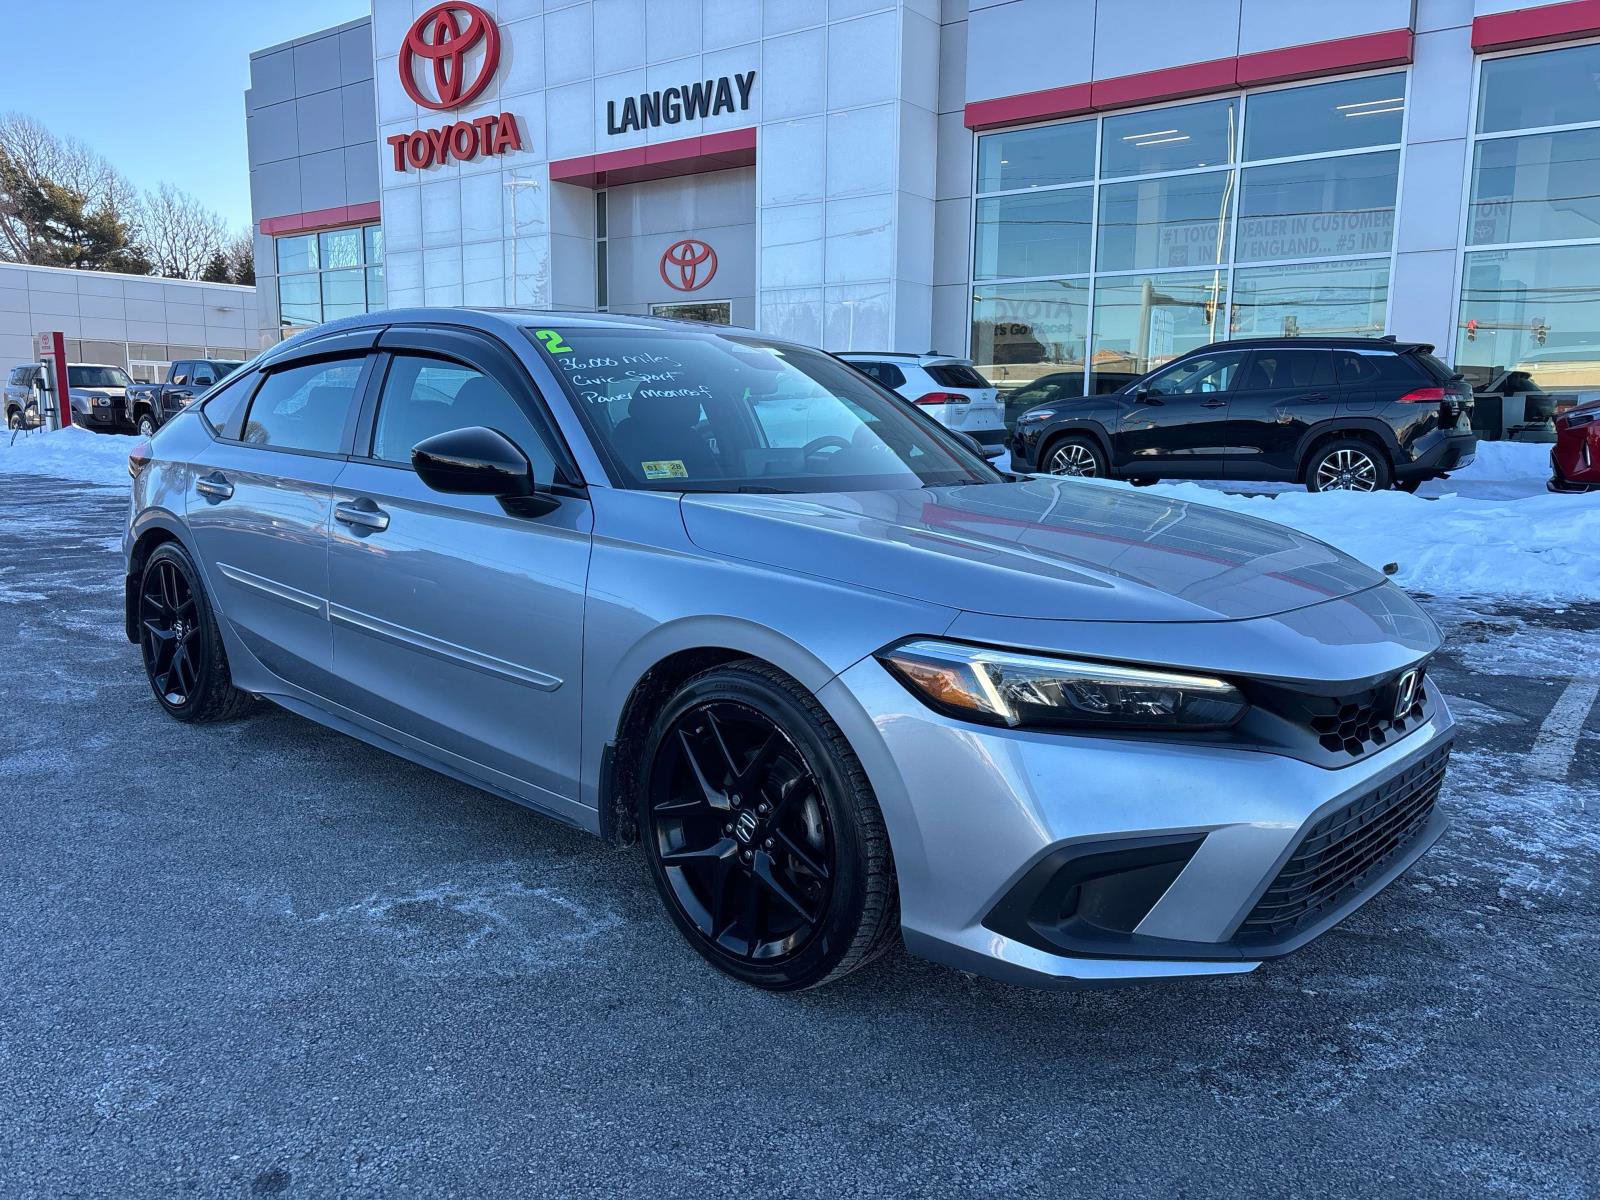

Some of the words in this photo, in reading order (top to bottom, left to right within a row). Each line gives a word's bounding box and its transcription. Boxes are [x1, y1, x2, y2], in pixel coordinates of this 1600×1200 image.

[607, 70, 756, 135] LANGWAY
[387, 112, 522, 172] TOYOTA
[1291, 217, 1307, 235] IN
[1199, 244, 1213, 262] IN
[1360, 231, 1378, 249] IN
[535, 330, 573, 354] 2
[572, 374, 621, 387] Civic
[580, 391, 633, 404] Power
